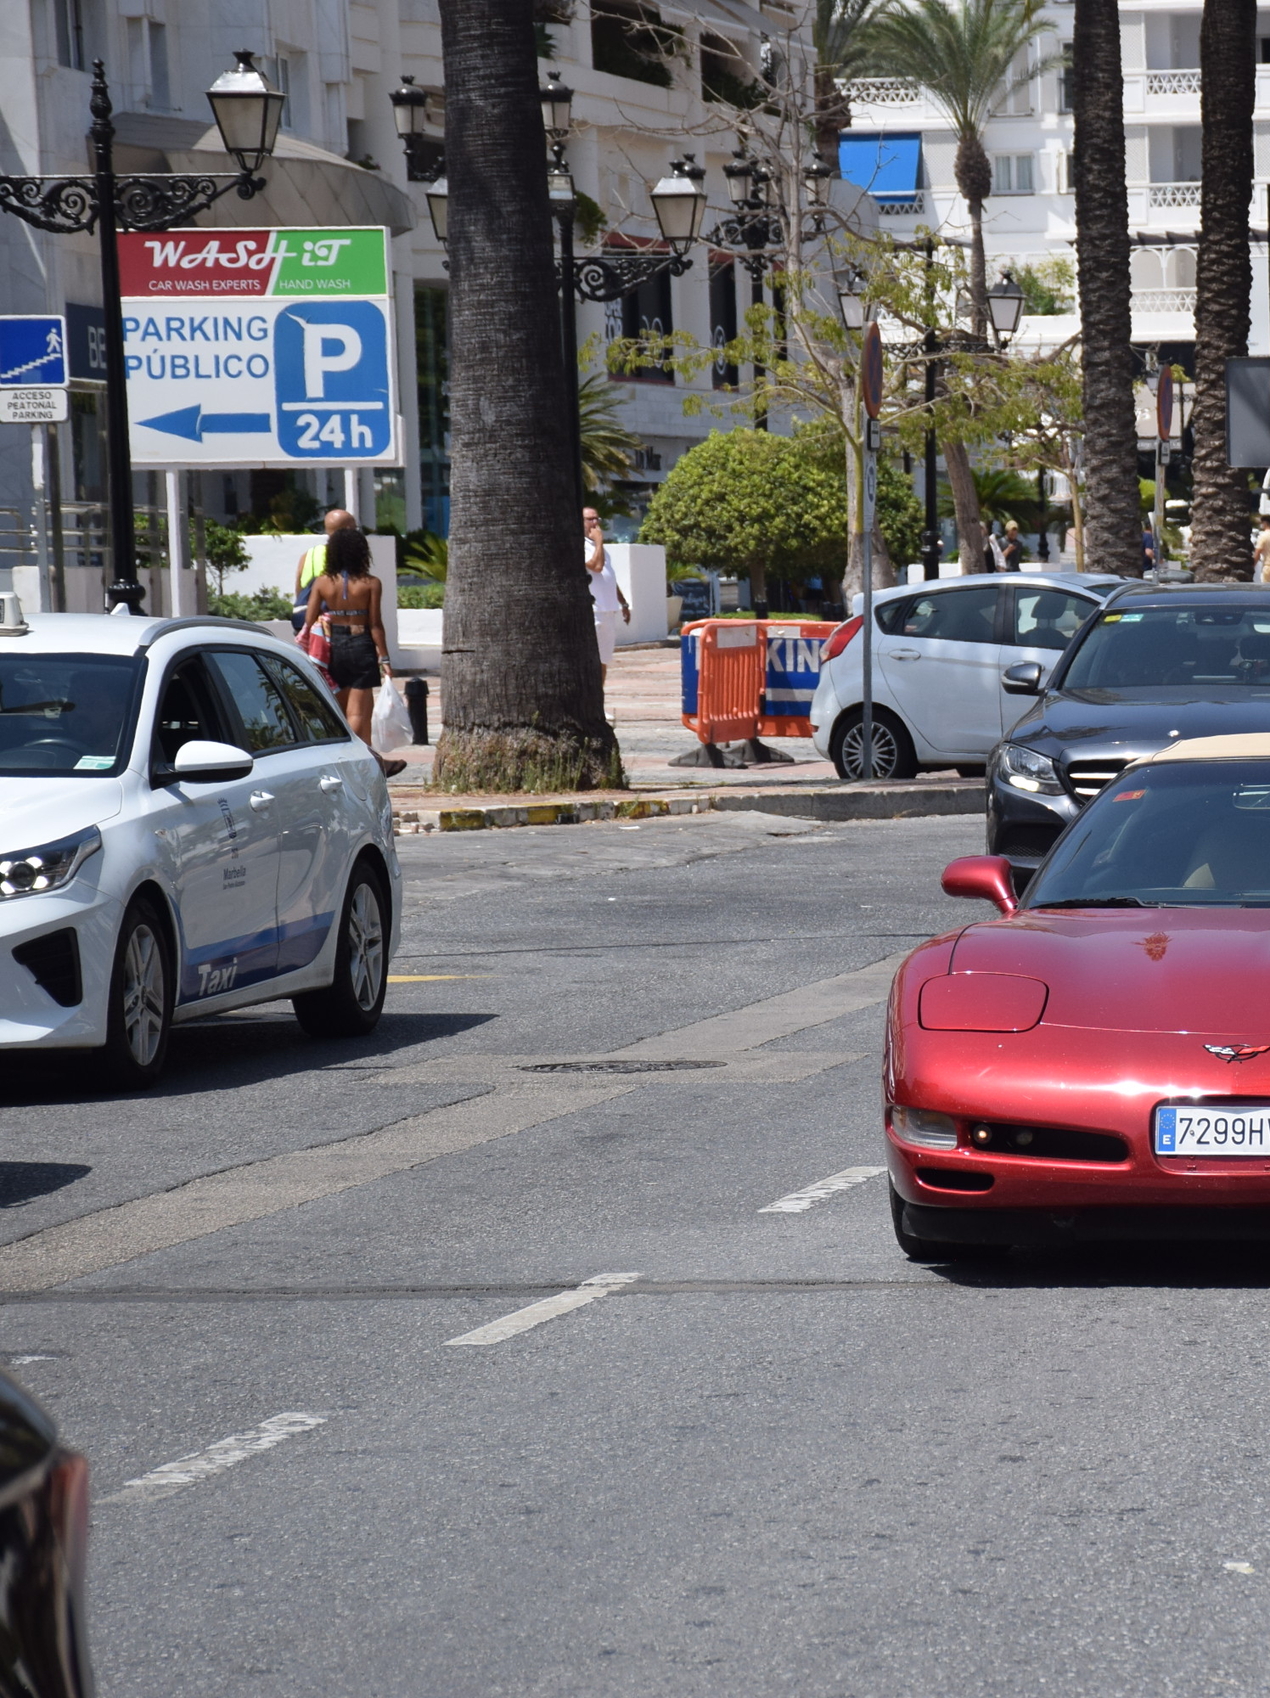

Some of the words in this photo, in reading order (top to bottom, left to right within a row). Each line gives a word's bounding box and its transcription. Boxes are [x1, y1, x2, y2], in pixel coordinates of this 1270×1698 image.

[149, 279, 172, 291] CAR
[174, 279, 210, 291] WASH
[213, 279, 261, 290] EXPERTS
[280, 279, 313, 290] HAND
[316, 278, 351, 289] WASH
[122, 316, 268, 343] PARKING
[124, 348, 270, 380] PÚBLICO
[304, 323, 362, 399] P
[12, 391, 52, 400] ACCESO
[7, 401, 57, 410] PEATONAL
[12, 411, 53, 419] PARKING
[296, 413, 373, 450] 24h
[198, 957, 238, 996] Taxi
[1162, 1134, 1172, 1145] E
